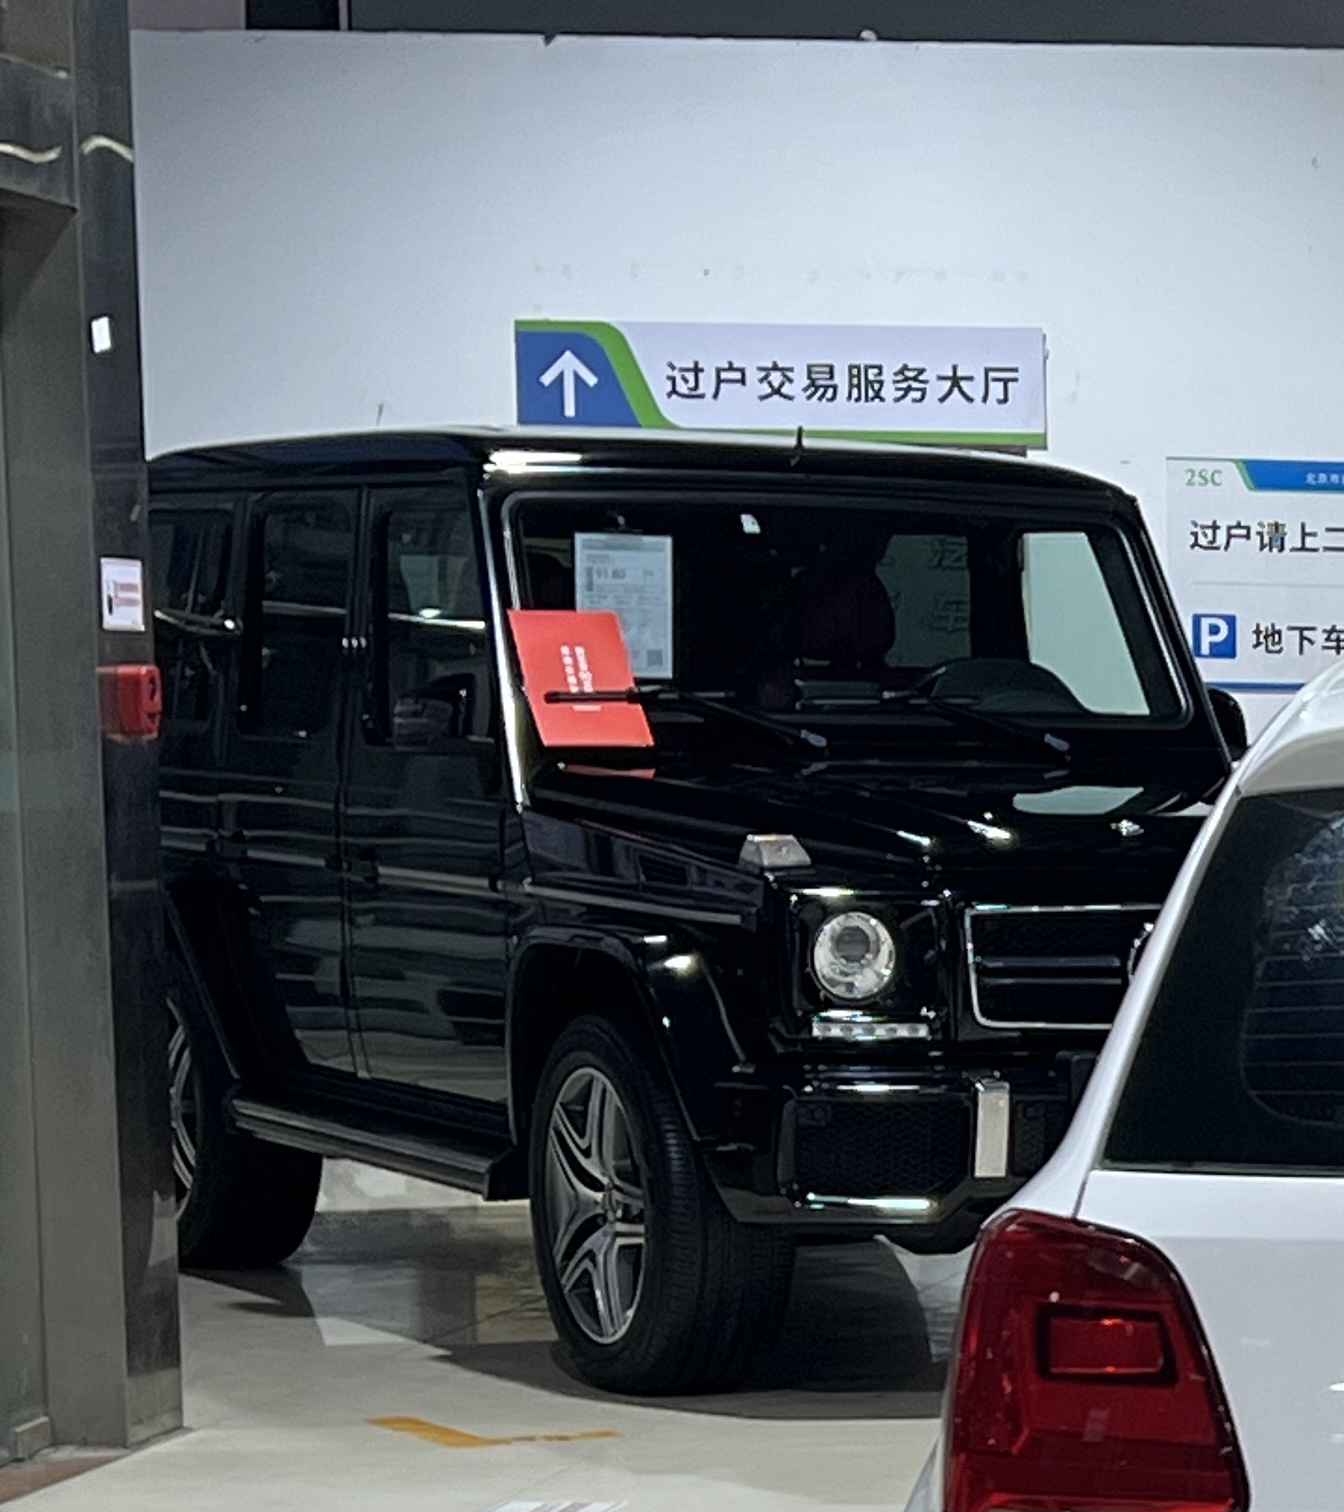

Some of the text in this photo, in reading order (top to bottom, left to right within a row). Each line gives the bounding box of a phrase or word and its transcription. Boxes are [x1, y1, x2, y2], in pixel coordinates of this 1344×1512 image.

[665, 360, 1021, 405] 过户交易服务大厅
[1184, 468, 1224, 488] 2SC
